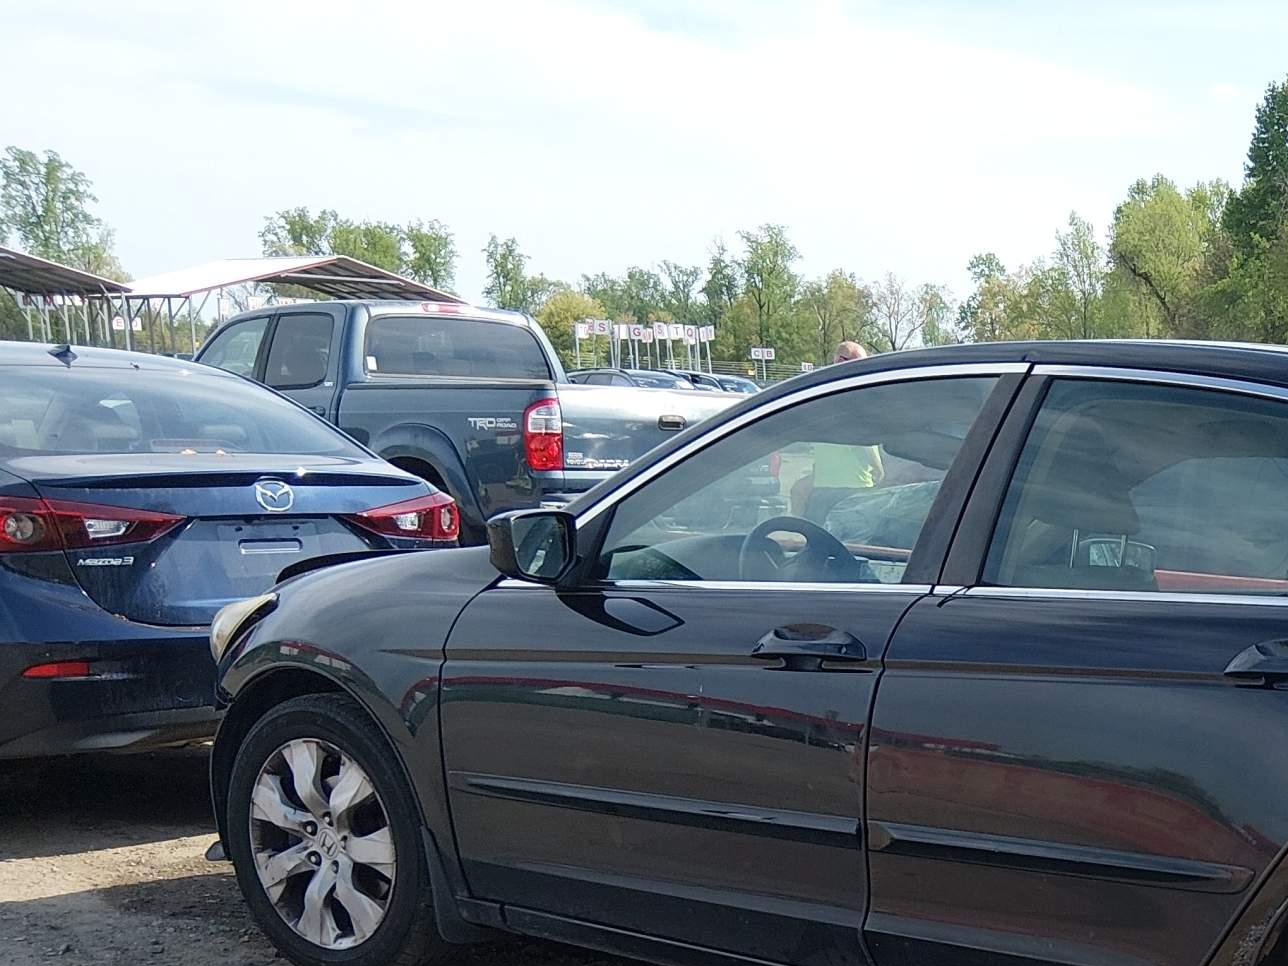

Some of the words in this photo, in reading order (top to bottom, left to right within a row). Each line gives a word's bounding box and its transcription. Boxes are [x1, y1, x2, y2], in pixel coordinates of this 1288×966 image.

[598, 322, 606, 332] S
[632, 327, 641, 337] G
[467, 417, 496, 431] TRD
